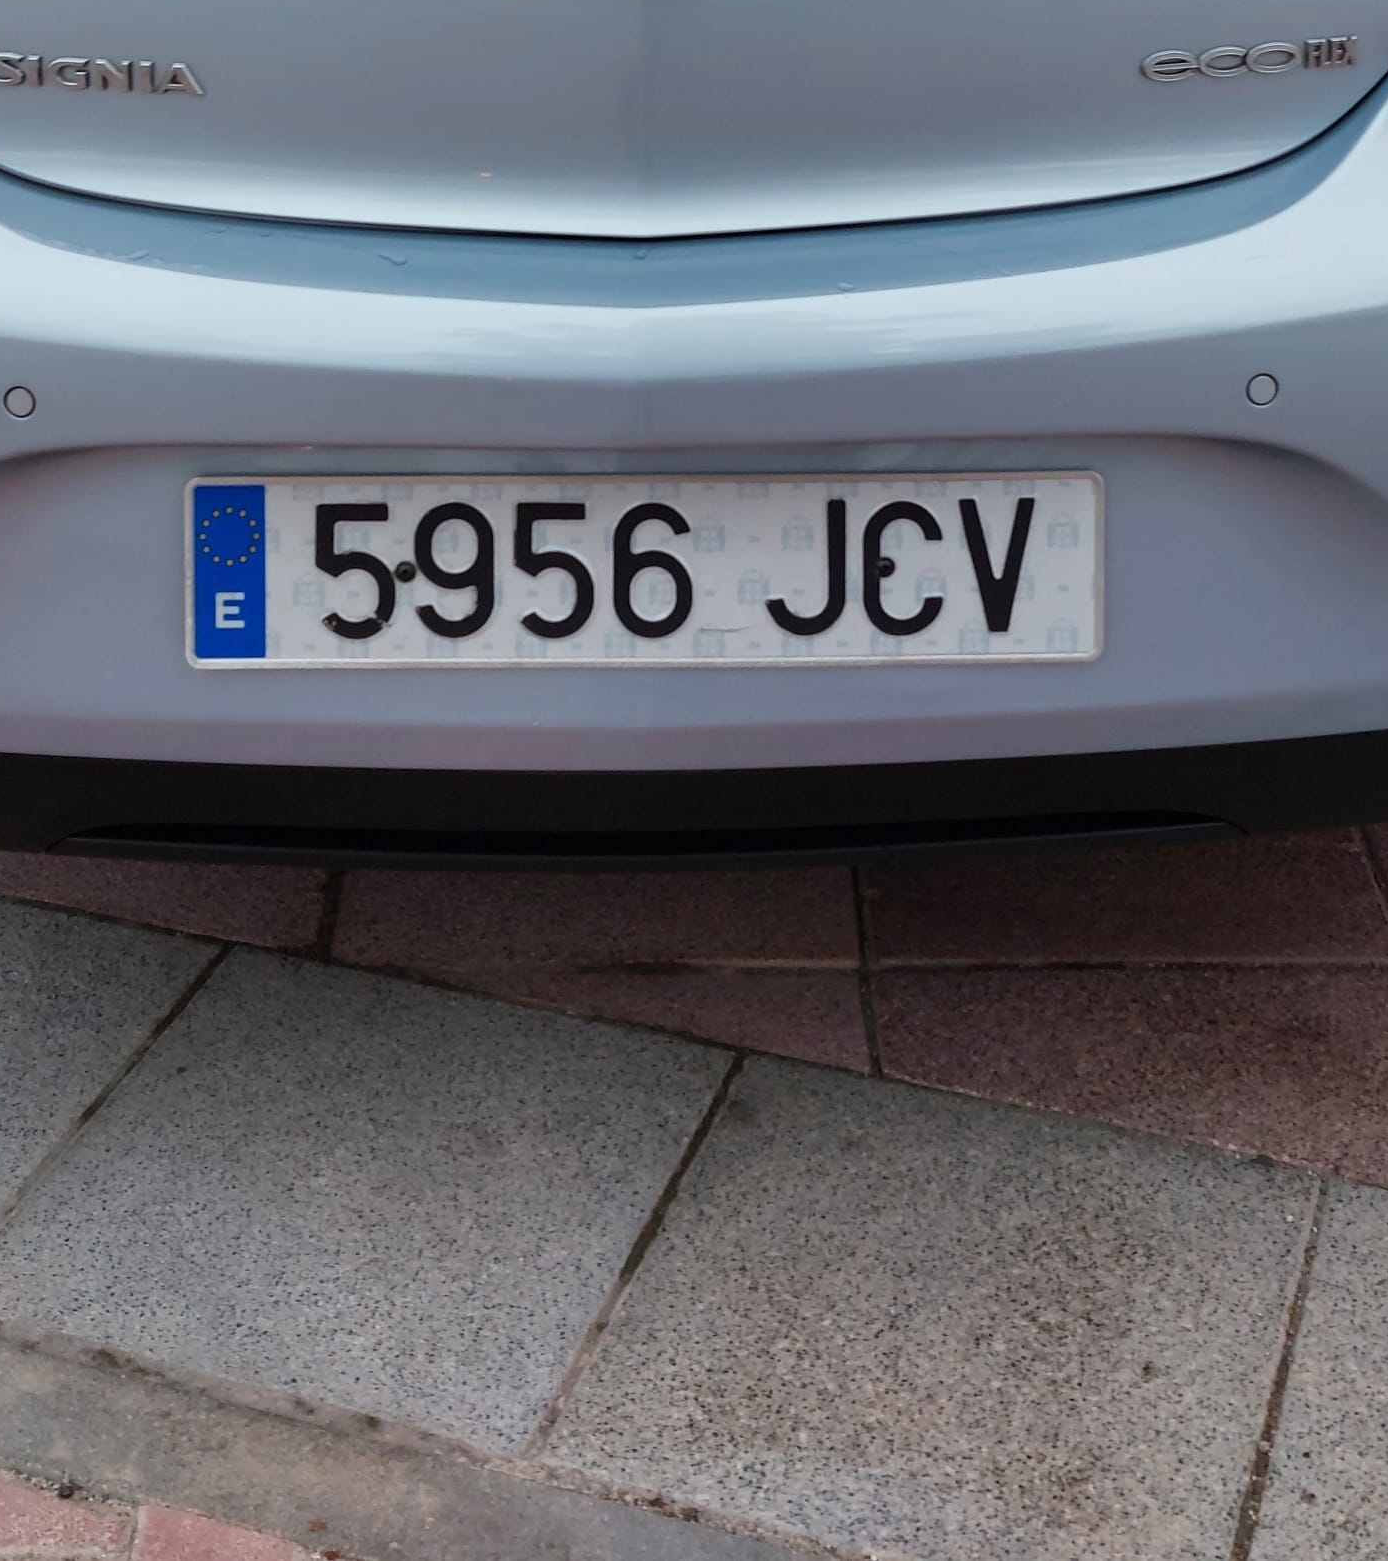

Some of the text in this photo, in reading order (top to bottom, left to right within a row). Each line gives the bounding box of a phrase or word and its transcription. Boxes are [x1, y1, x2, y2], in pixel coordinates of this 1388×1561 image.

[213, 496, 1037, 640] E 5956 JCV
